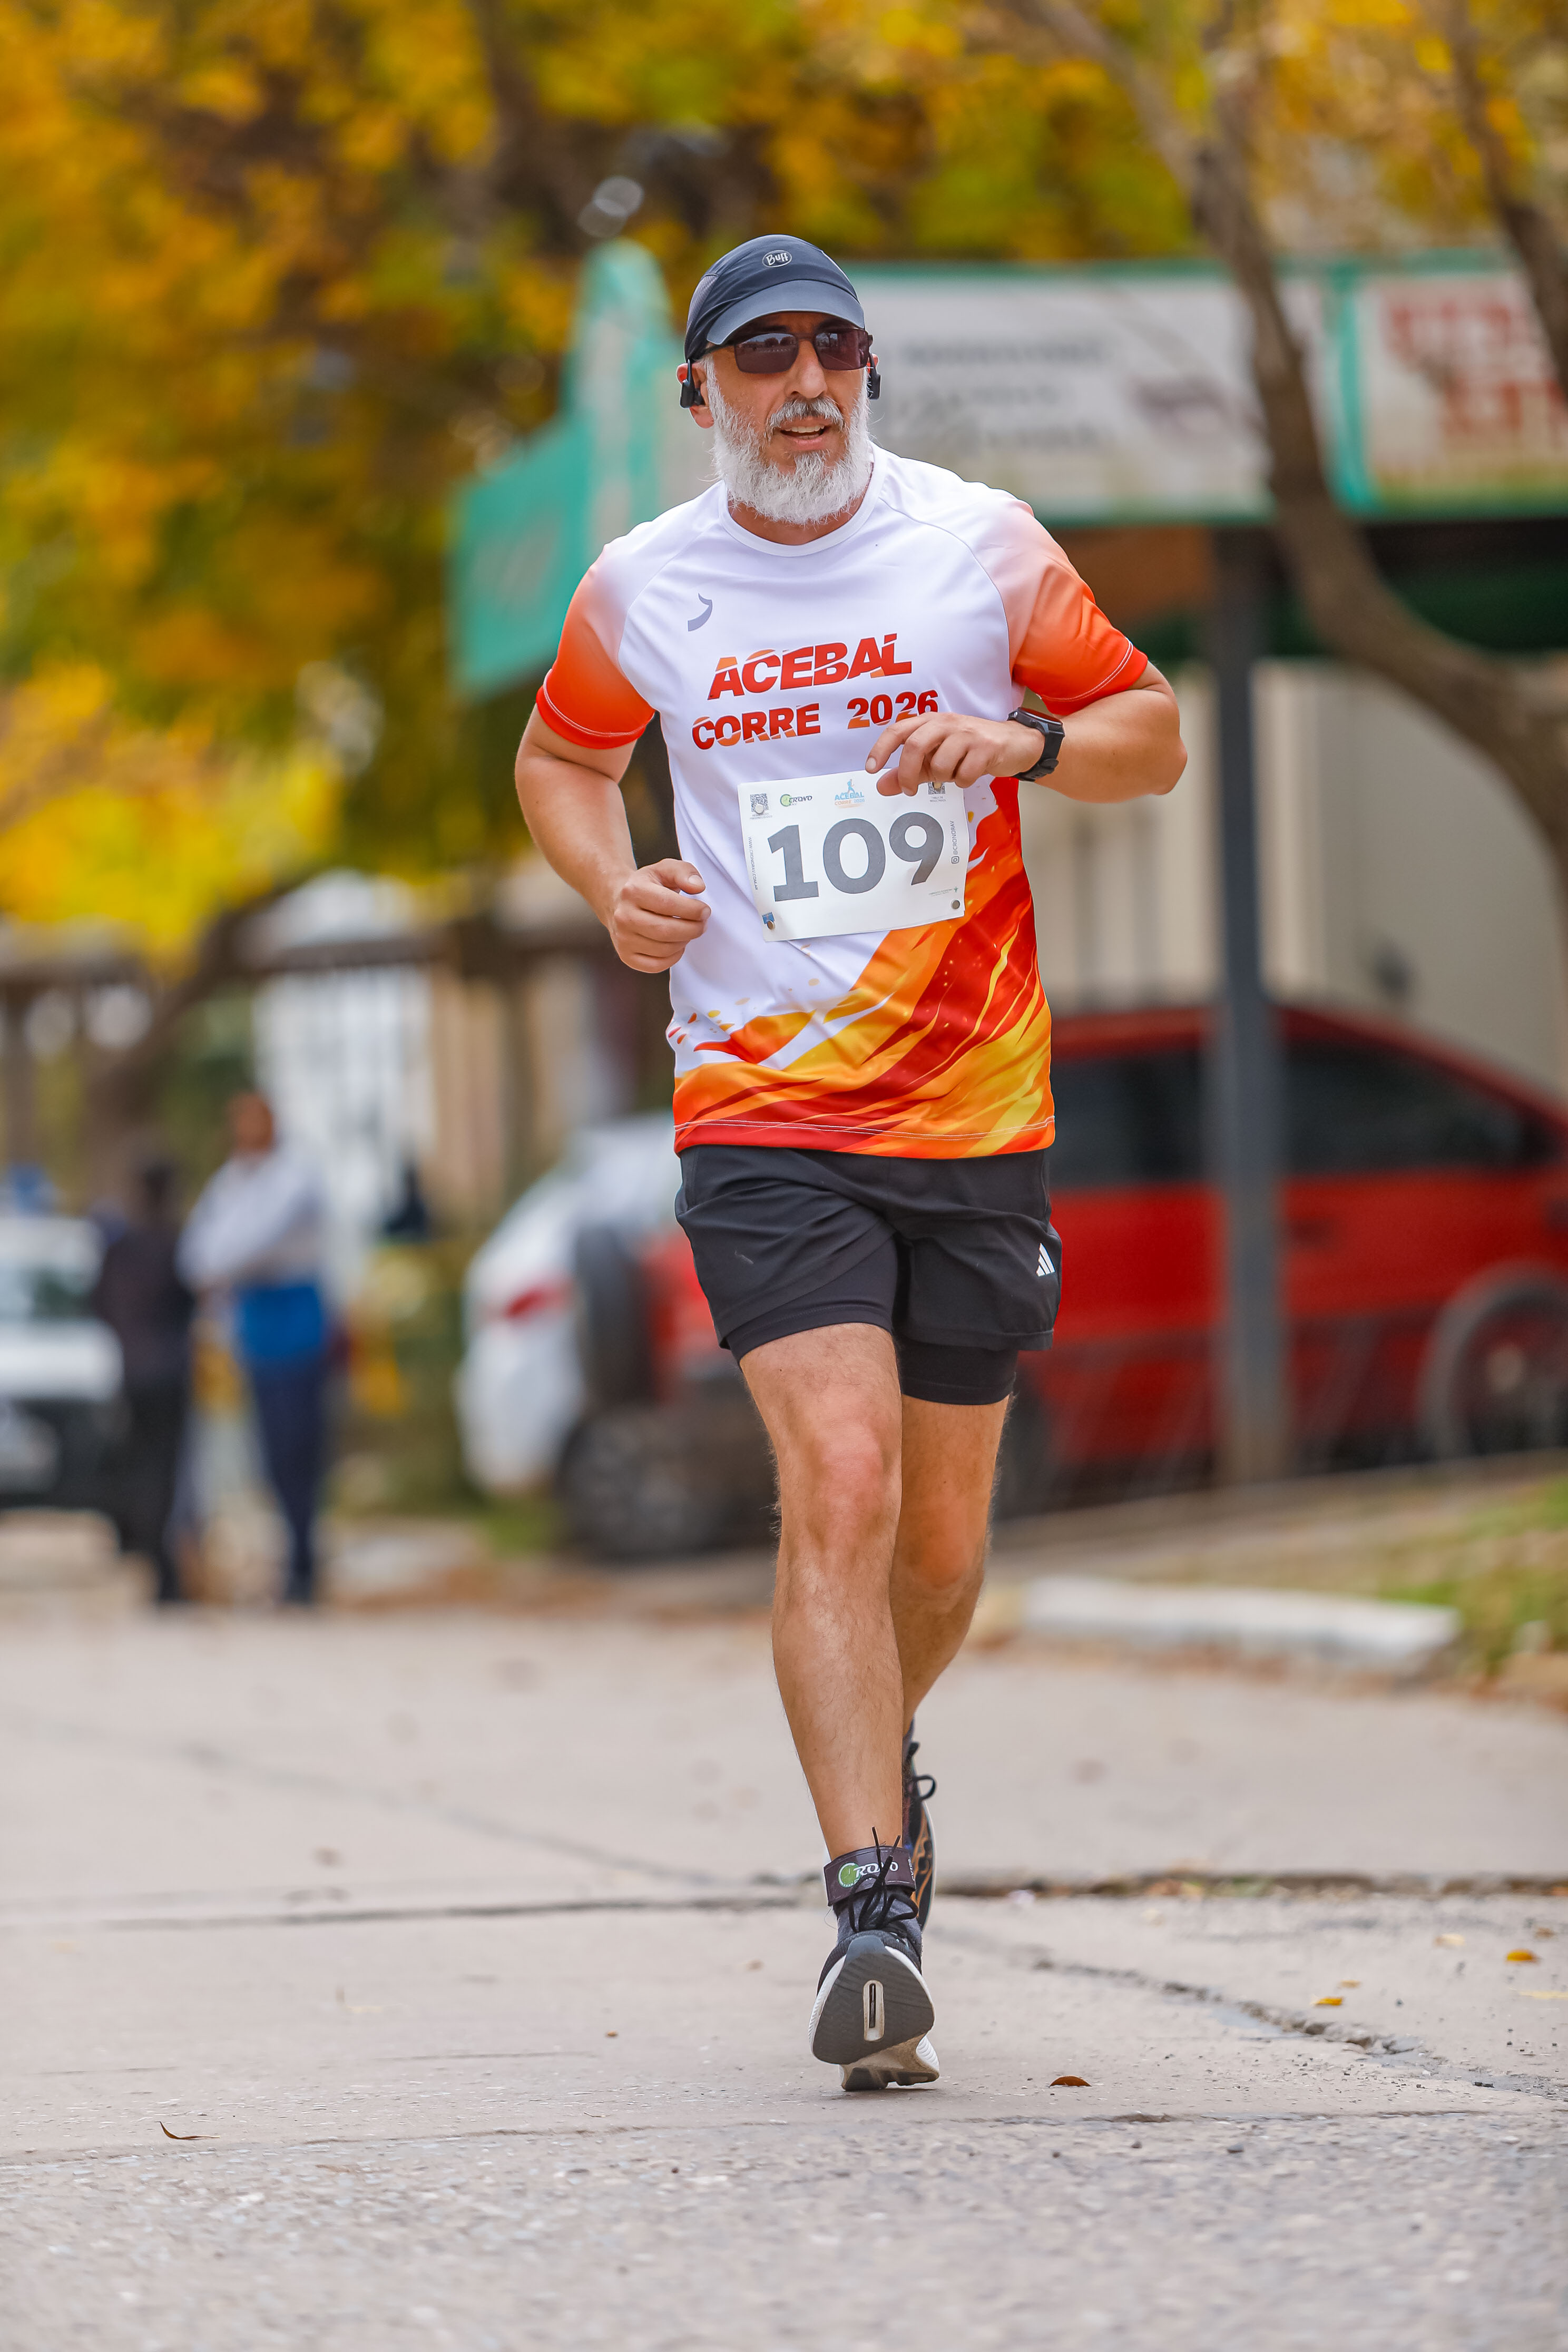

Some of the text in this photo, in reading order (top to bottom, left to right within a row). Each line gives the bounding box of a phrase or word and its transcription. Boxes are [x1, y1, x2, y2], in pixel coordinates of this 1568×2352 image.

[766, 253, 788, 266] Buff
[707, 633, 912, 700] ACEBAL
[692, 689, 938, 750] CORRE 2026
[835, 792, 864, 800] ACEBAL
[949, 821, 959, 855] @CRONORAV
[767, 812, 944, 901] 109
[838, 1861, 898, 1887] CROO
